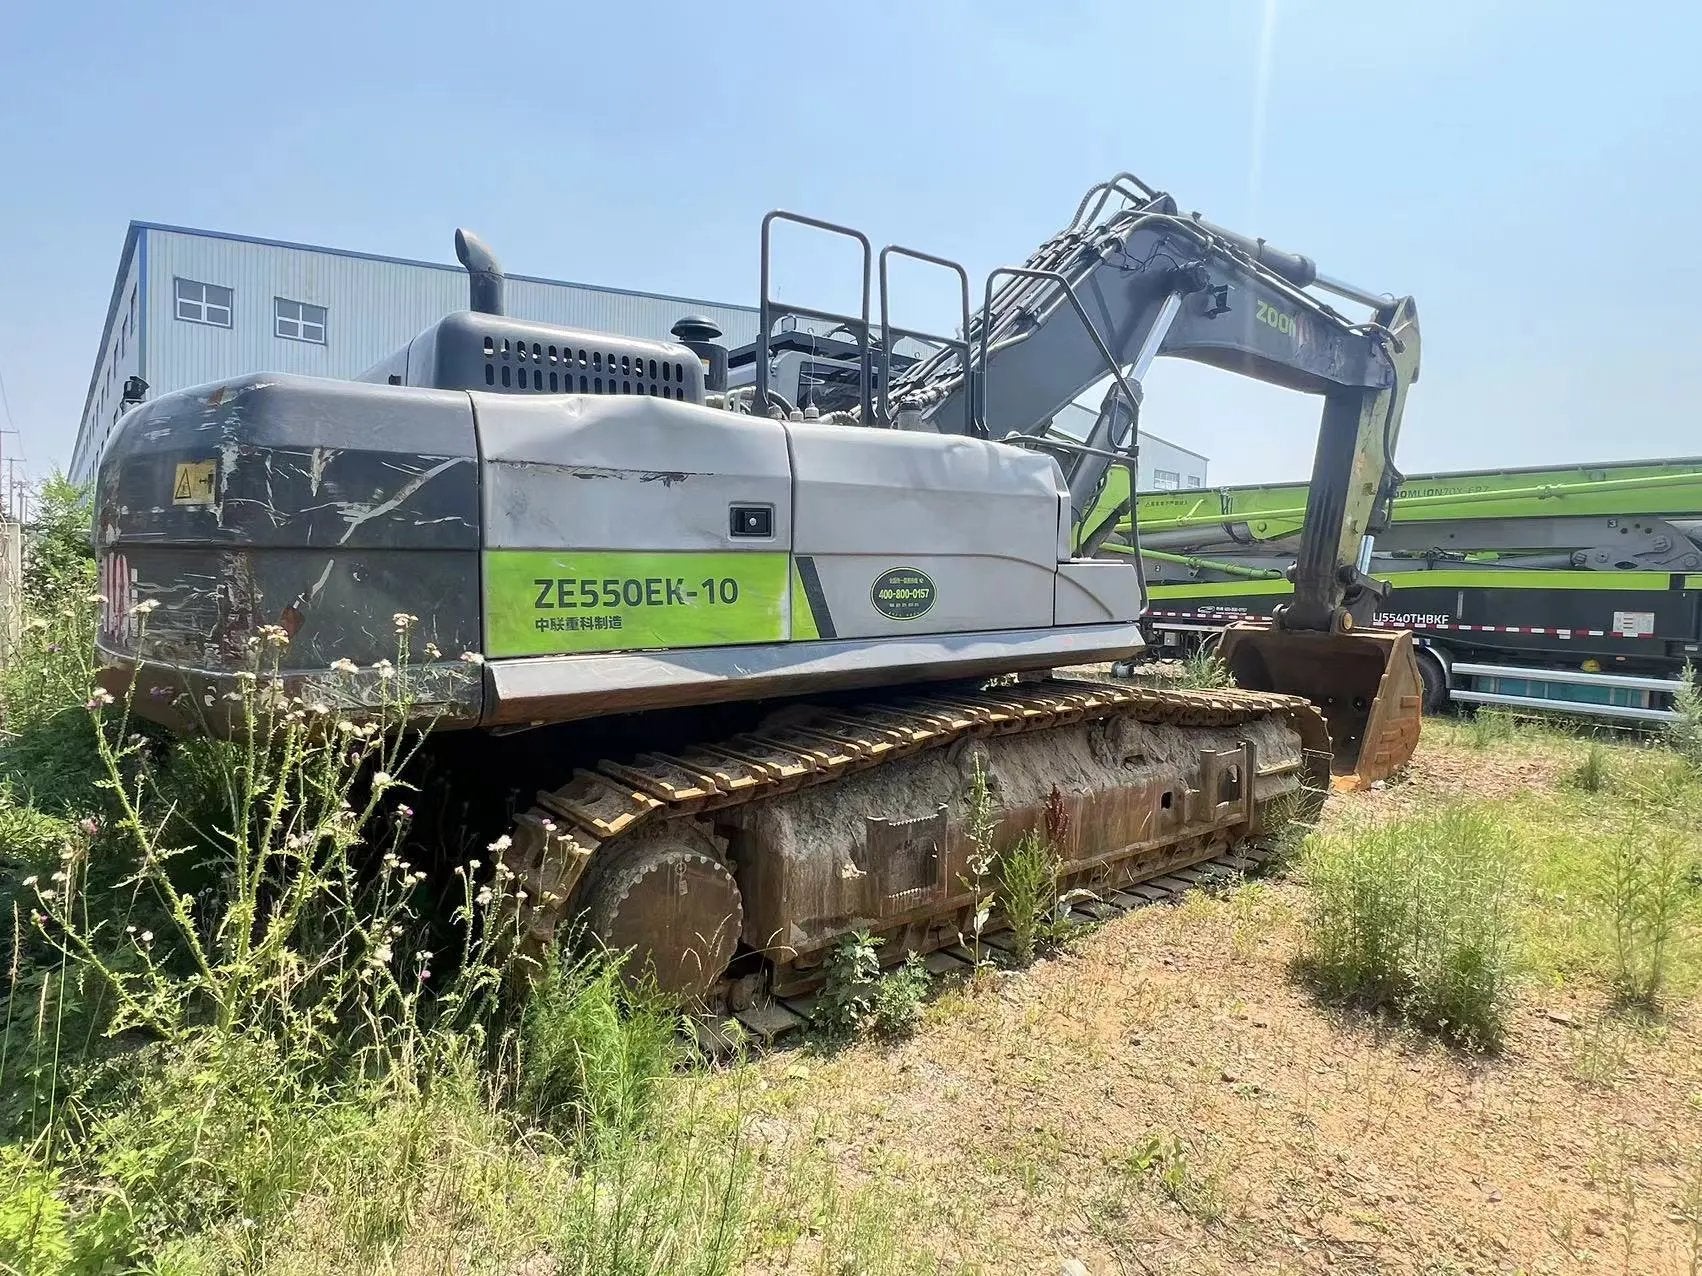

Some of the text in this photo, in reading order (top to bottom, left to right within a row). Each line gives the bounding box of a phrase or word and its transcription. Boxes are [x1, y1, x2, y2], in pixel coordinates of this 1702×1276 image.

[1608, 519, 1616, 528] 3
[534, 578, 739, 609] ZE550EK-10
[879, 588, 930, 600] 400-800-0157
[535, 615, 623, 633] 中联重科制造
